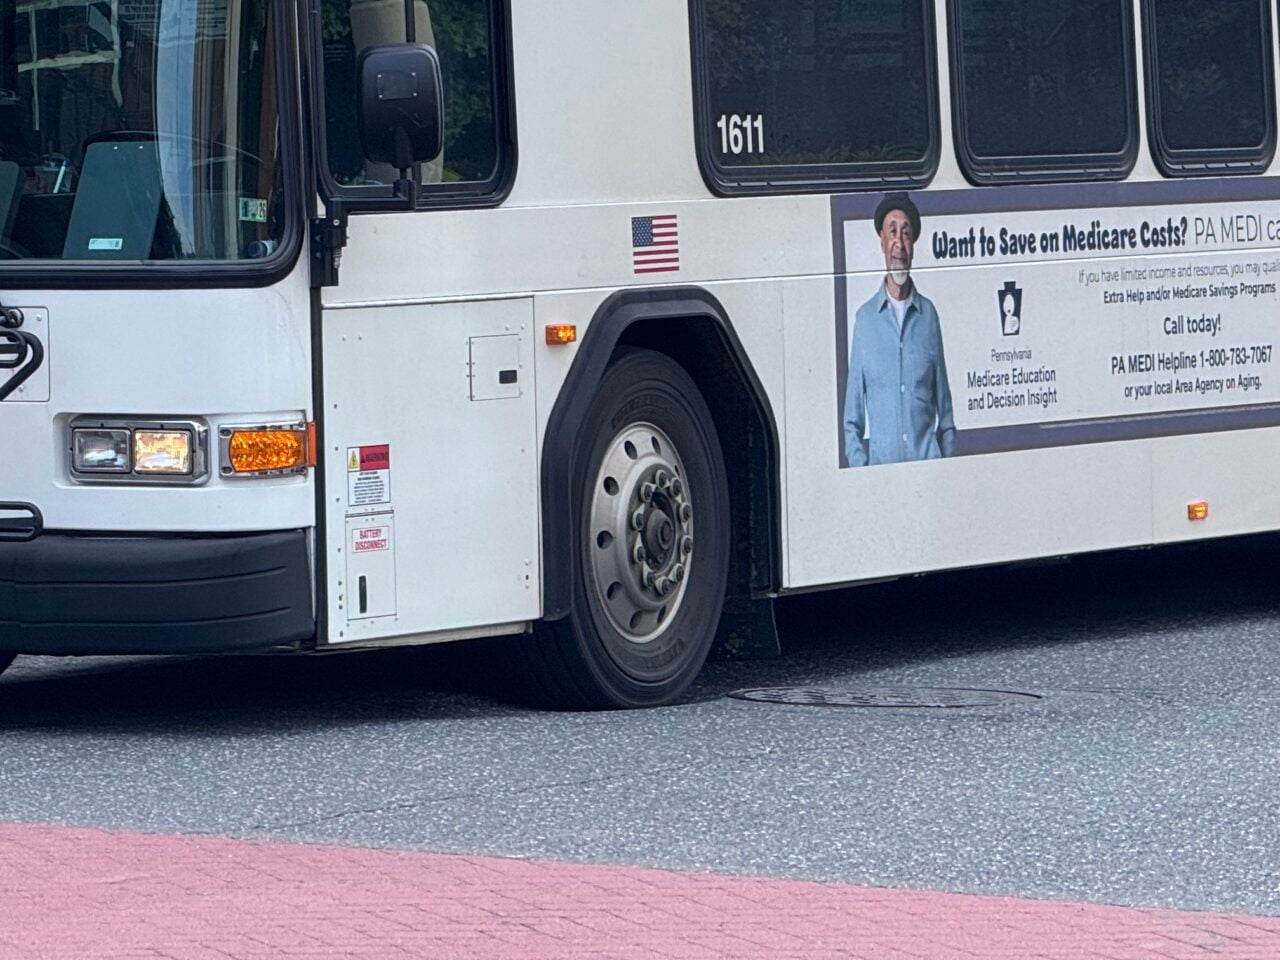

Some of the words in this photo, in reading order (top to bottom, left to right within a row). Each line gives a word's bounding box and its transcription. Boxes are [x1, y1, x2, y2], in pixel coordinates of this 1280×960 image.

[717, 114, 764, 154] 1611
[932, 227, 976, 260] Want
[979, 225, 996, 257] to
[999, 226, 1036, 256] Save
[1040, 230, 1058, 254] on
[1062, 219, 1137, 252] Medicare
[1140, 216, 1188, 247] Costs?
[1194, 216, 1217, 245] PA
[1221, 213, 1263, 243] MEDI
[1086, 273, 1100, 286] you
[1101, 269, 1120, 282] have
[1121, 267, 1147, 281] limited
[1149, 266, 1176, 279] income
[1177, 264, 1192, 277] and
[1230, 264, 1244, 278] you
[1245, 262, 1261, 277] may
[1104, 290, 1125, 304] Extra
[1126, 289, 1145, 305] Help
[1147, 285, 1171, 302] and/or
[1172, 285, 1208, 300] Medicare
[1209, 283, 1239, 299] Savings
[1240, 282, 1276, 297] Programs
[1163, 315, 1184, 335] Call
[1187, 314, 1221, 337] today!
[991, 348, 1032, 362] Pennsylvania
[1111, 356, 1126, 375] PA
[1128, 353, 1155, 373] MEDI
[1158, 349, 1197, 373] Helpline
[1200, 345, 1273, 368] 1-800-783-7067
[967, 370, 1010, 389] Medicare
[1012, 366, 1056, 385] Education
[1124, 385, 1134, 398] or
[1134, 384, 1152, 400] your
[1154, 379, 1173, 395] local
[1175, 378, 1193, 393] Area
[1195, 376, 1225, 395] Agency
[1226, 377, 1236, 390] on
[1238, 373, 1263, 393] Aging.
[968, 392, 985, 411] and
[987, 389, 1026, 409] Decision
[1028, 388, 1057, 408] Insight
[355, 539, 387, 551] DISCONNECT
[359, 528, 382, 540] BATTERY
